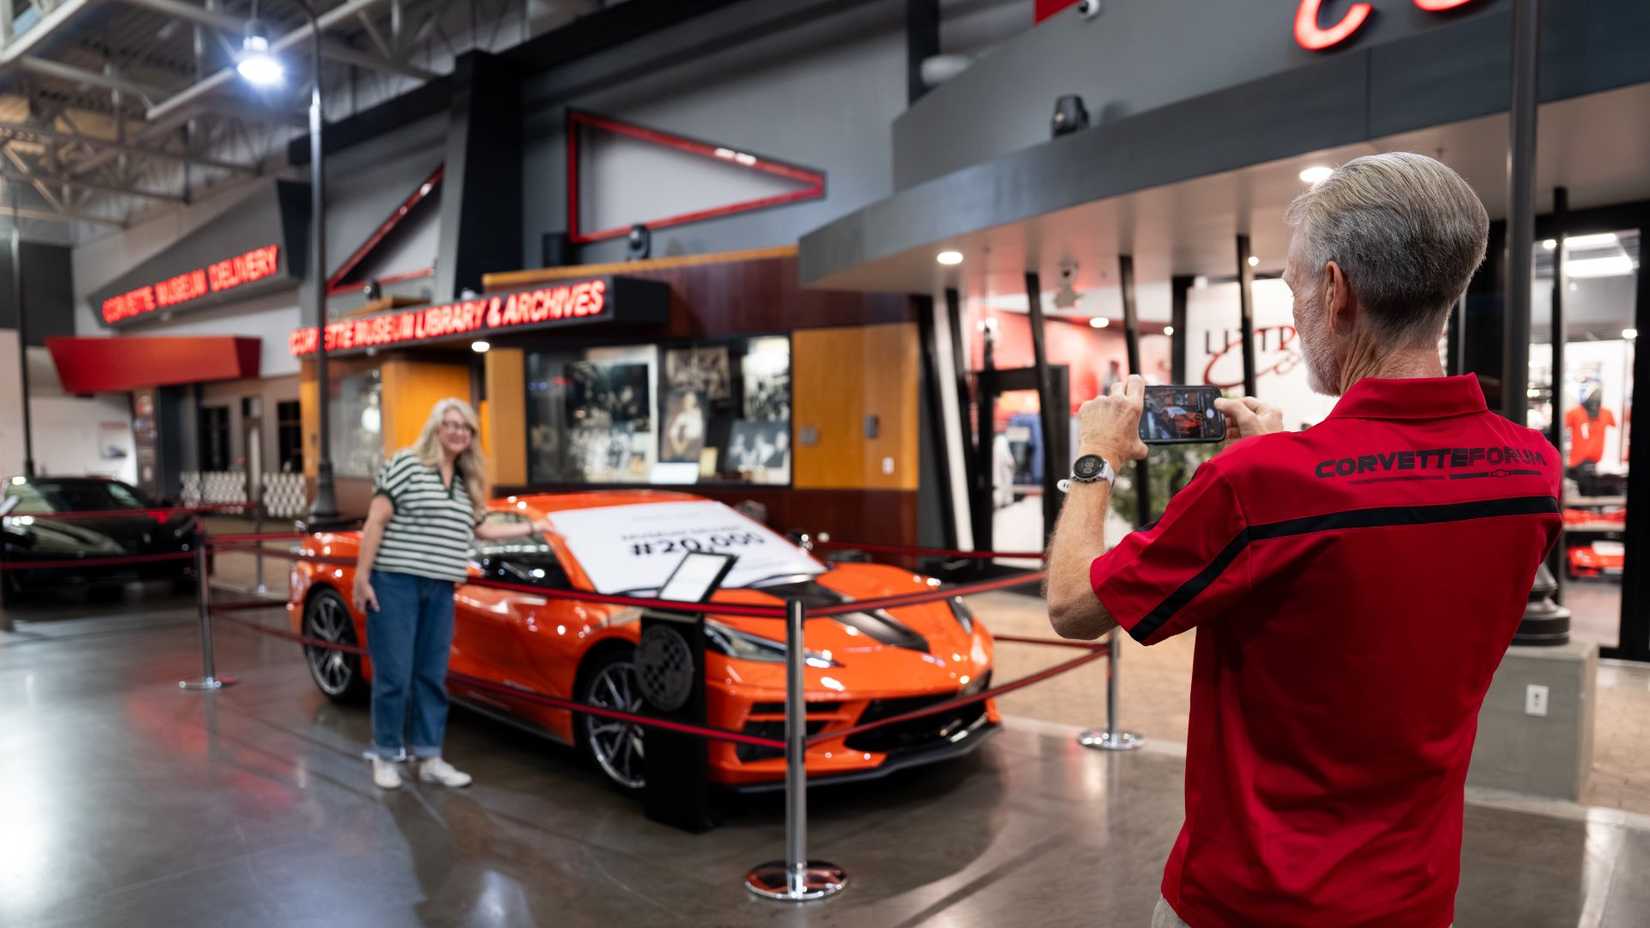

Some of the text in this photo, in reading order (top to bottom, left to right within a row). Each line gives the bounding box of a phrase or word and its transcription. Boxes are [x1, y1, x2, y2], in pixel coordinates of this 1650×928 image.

[208, 243, 280, 293] DELIVERY
[354, 312, 414, 347] MUSEUM
[415, 299, 488, 339] LIBRARY
[486, 296, 501, 329] &
[502, 279, 606, 326] ARCHIVES
[1315, 446, 1547, 480] CORVETTEFORUM
